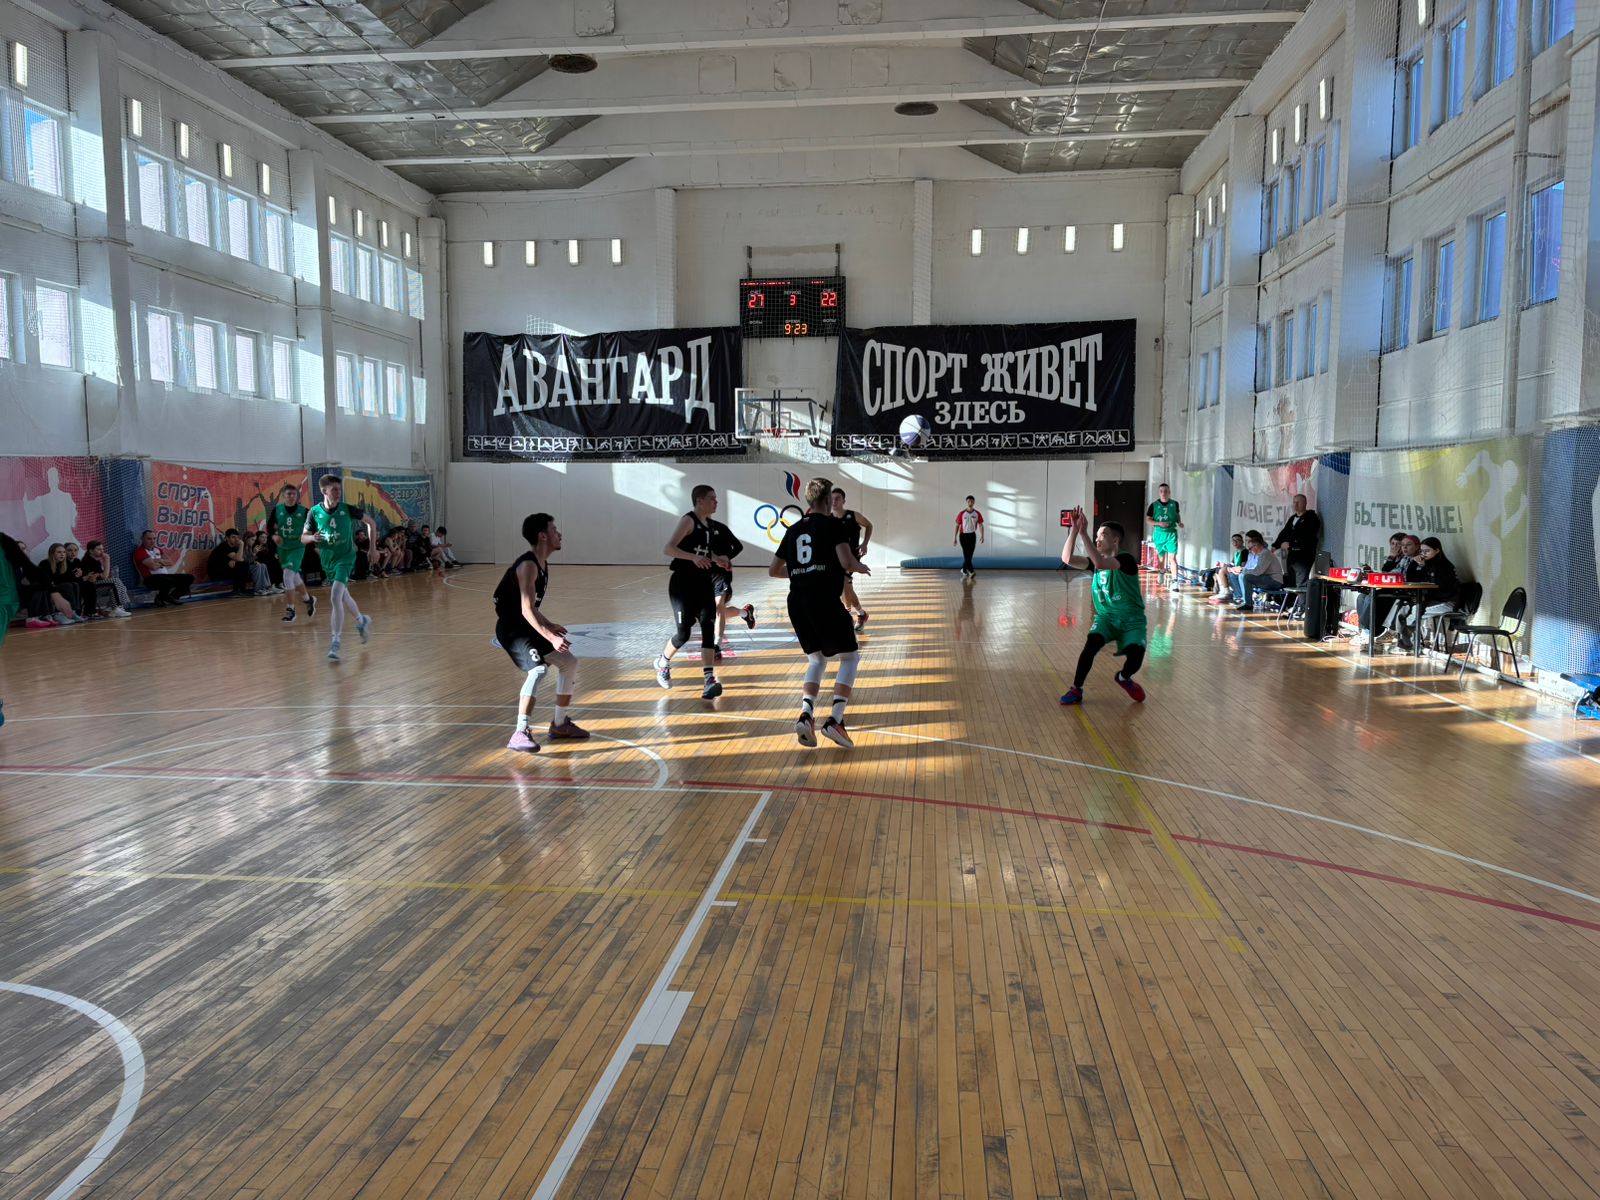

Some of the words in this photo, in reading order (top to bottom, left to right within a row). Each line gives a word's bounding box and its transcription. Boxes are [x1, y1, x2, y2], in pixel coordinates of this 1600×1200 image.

[749, 294, 764, 308] 27
[790, 295, 796, 305] 3
[821, 292, 837, 307] 22
[784, 323, 808, 335] 9:23
[862, 338, 968, 417] СПОРТ
[980, 332, 1103, 412] ЖИВЕТ
[493, 335, 716, 431] АВАНГАРД
[934, 400, 1026, 430] ЗДЕСЬ
[286, 517, 293, 526] 8
[329, 517, 337, 529] 4
[796, 533, 812, 564] 6
[1100, 571, 1107, 585] 5
